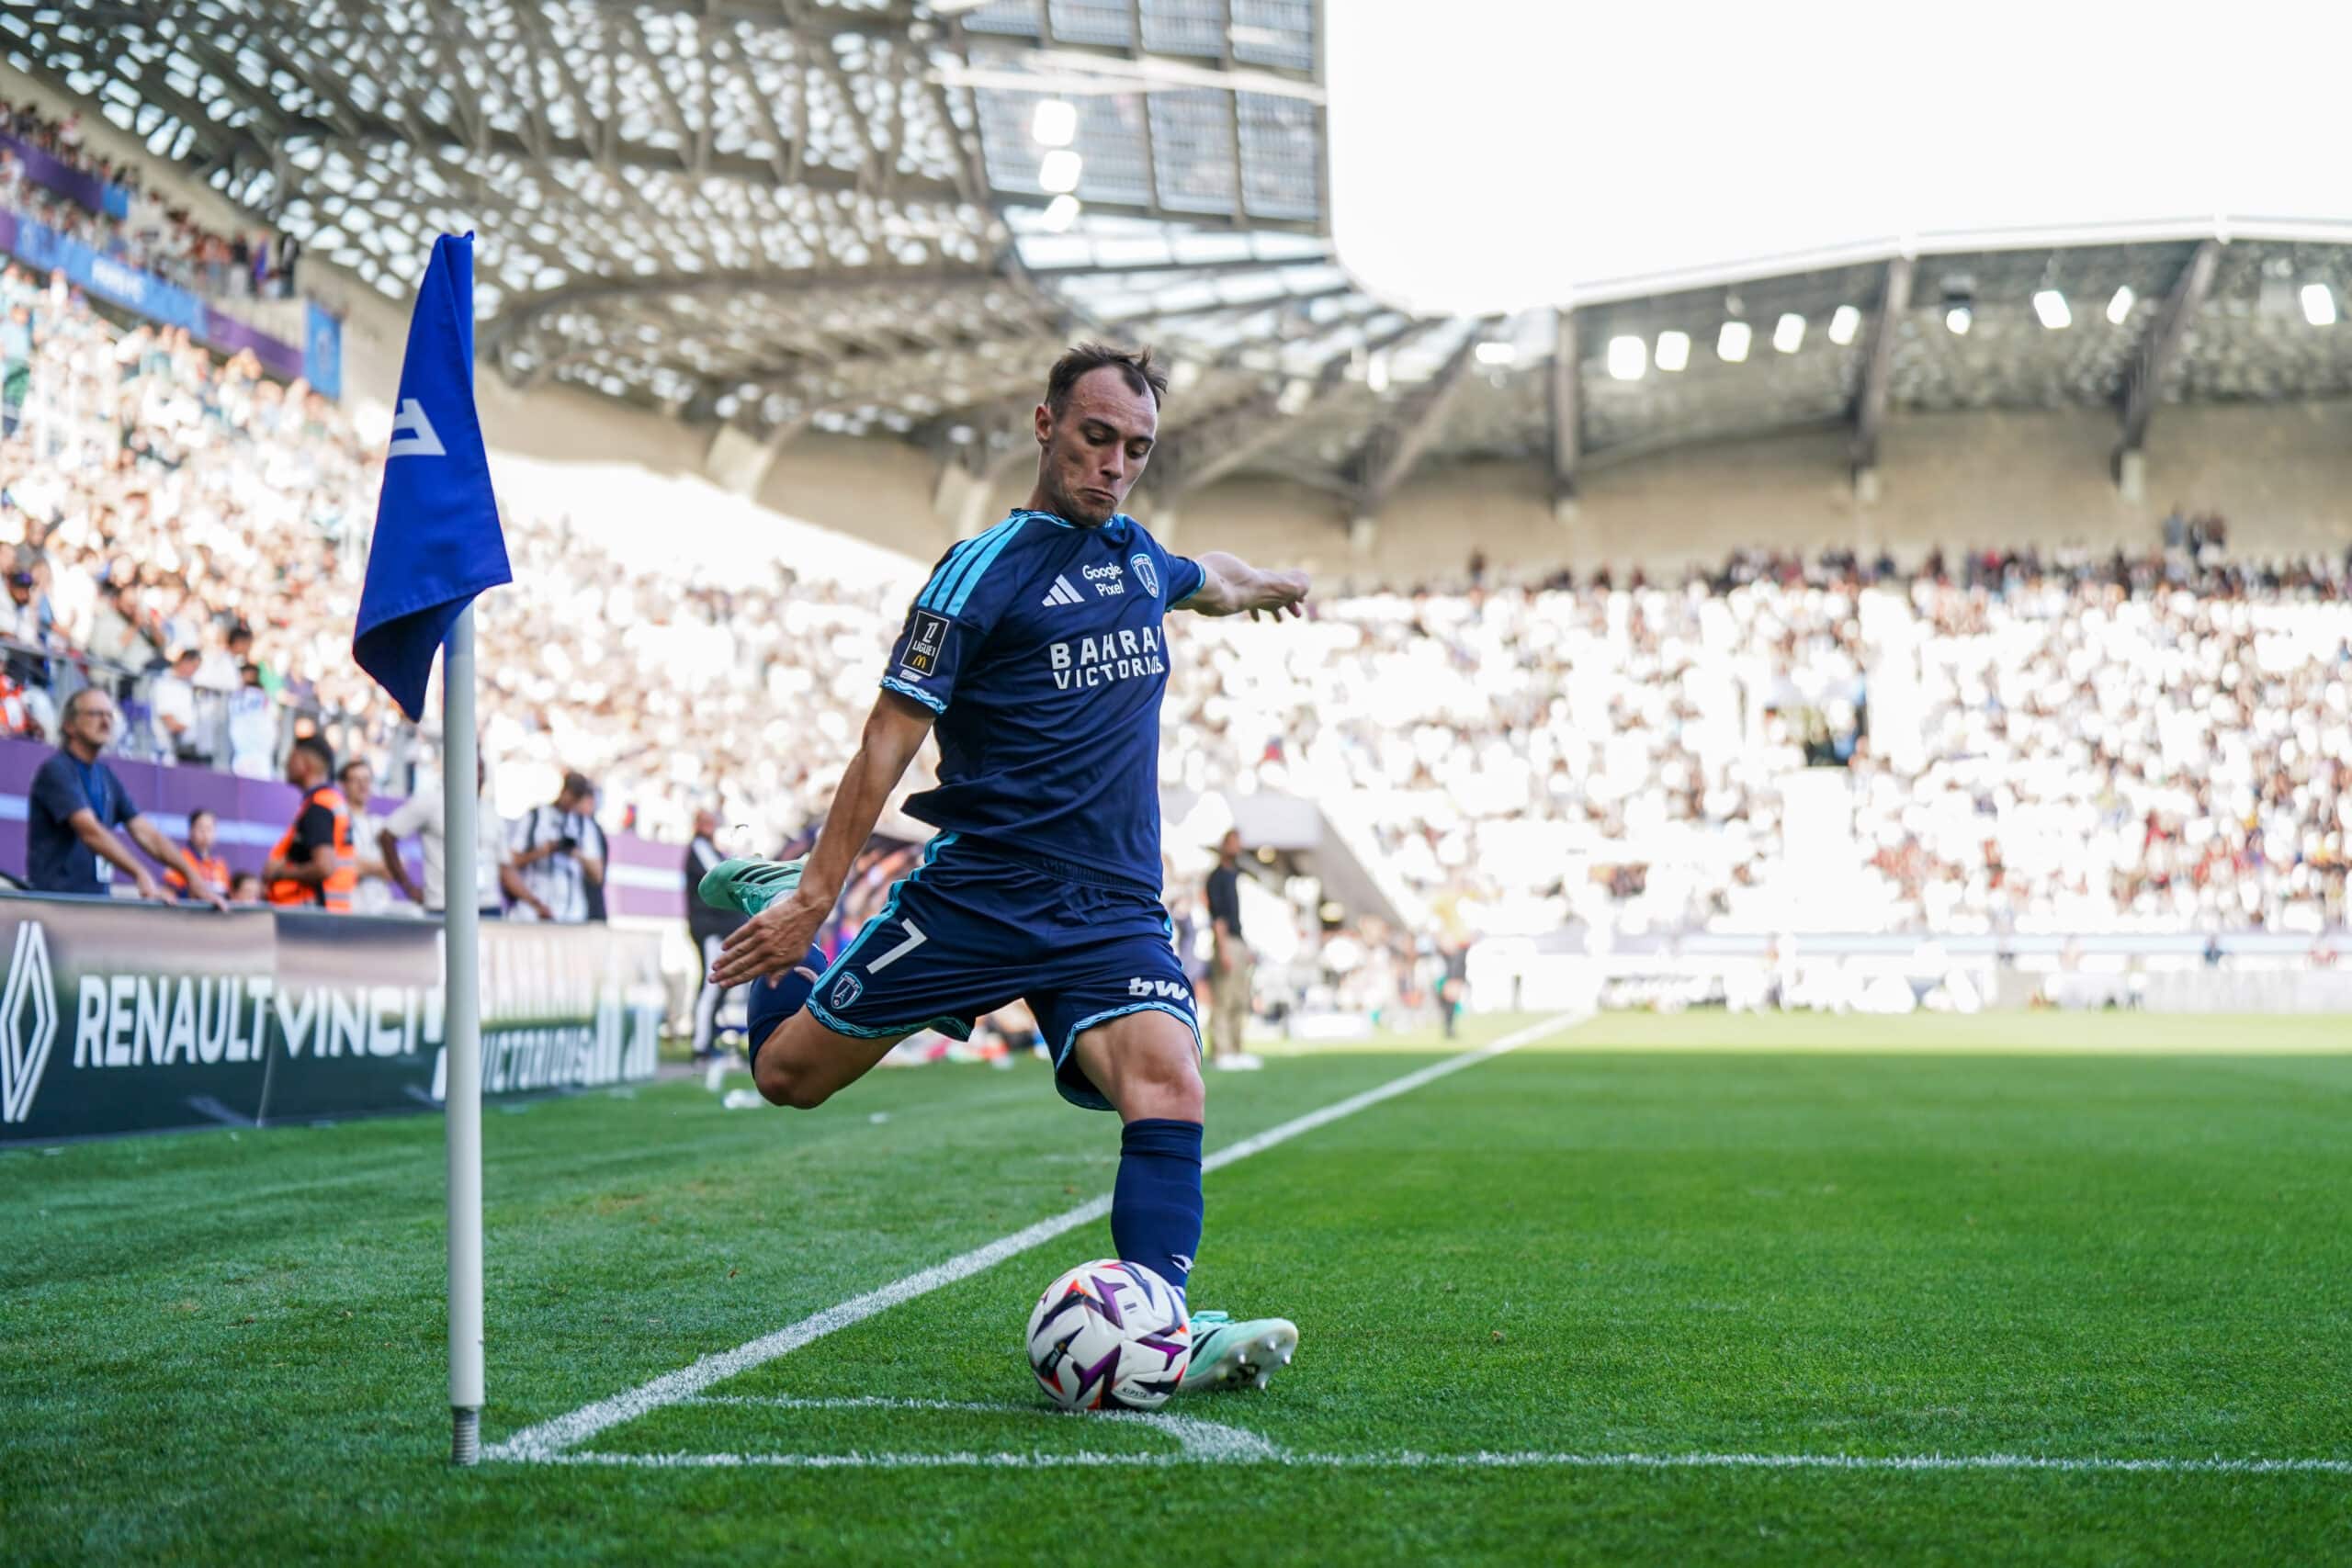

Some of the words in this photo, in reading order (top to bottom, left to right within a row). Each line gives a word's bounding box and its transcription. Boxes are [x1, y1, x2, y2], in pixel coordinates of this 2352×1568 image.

[1082, 562, 1123, 580] Google
[1095, 579, 1125, 596] Pixel
[912, 640, 933, 656] LIGUE
[866, 918, 927, 975] 7
[74, 975, 273, 1068] RENAULT
[277, 985, 417, 1058] VINCI
